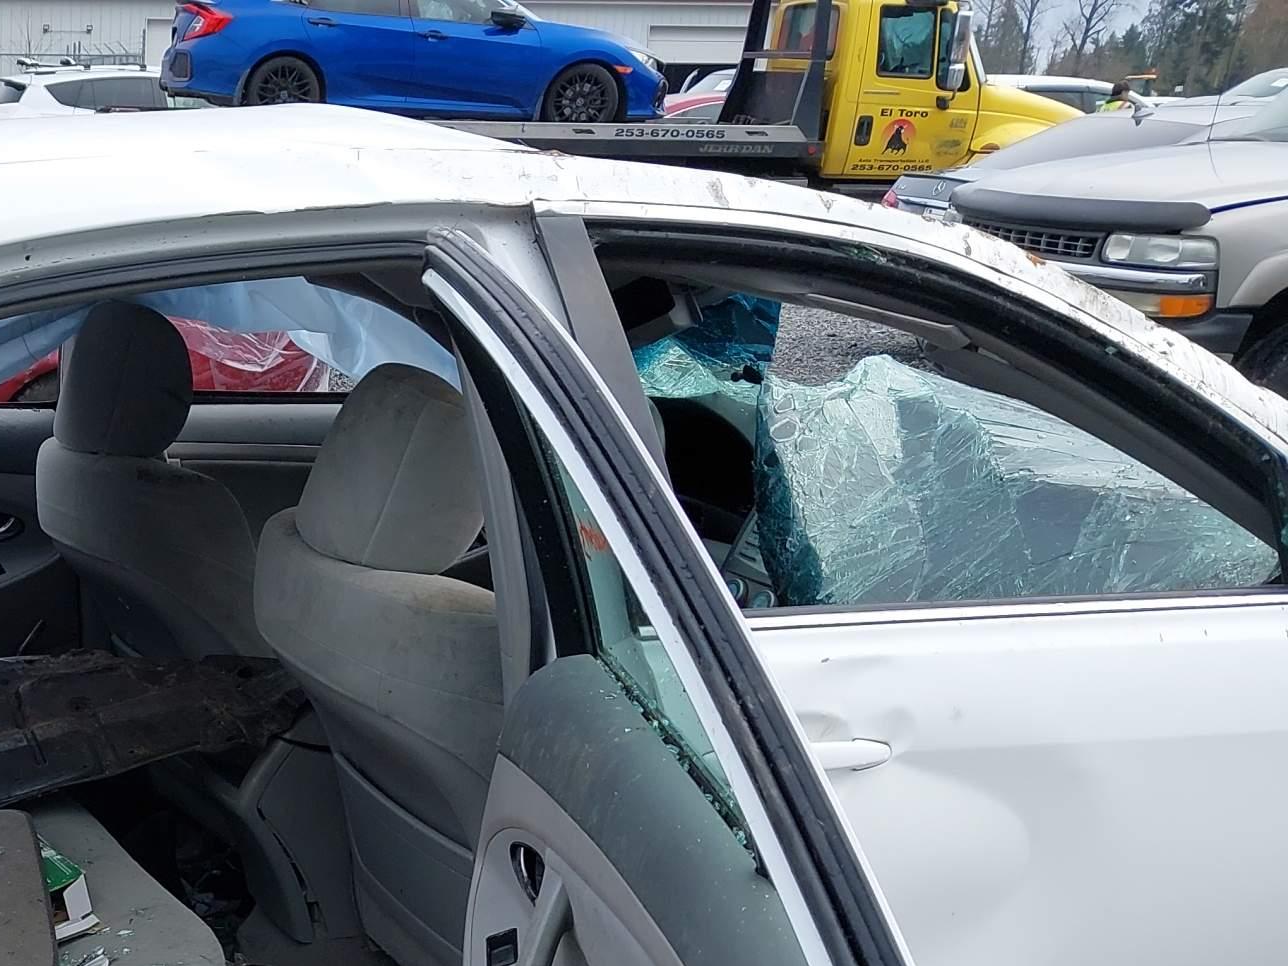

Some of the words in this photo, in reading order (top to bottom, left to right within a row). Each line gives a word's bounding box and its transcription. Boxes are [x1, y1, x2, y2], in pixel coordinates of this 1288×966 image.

[880, 108, 893, 117] El
[897, 108, 929, 118] Toro
[614, 128, 726, 139] 253-670-0565
